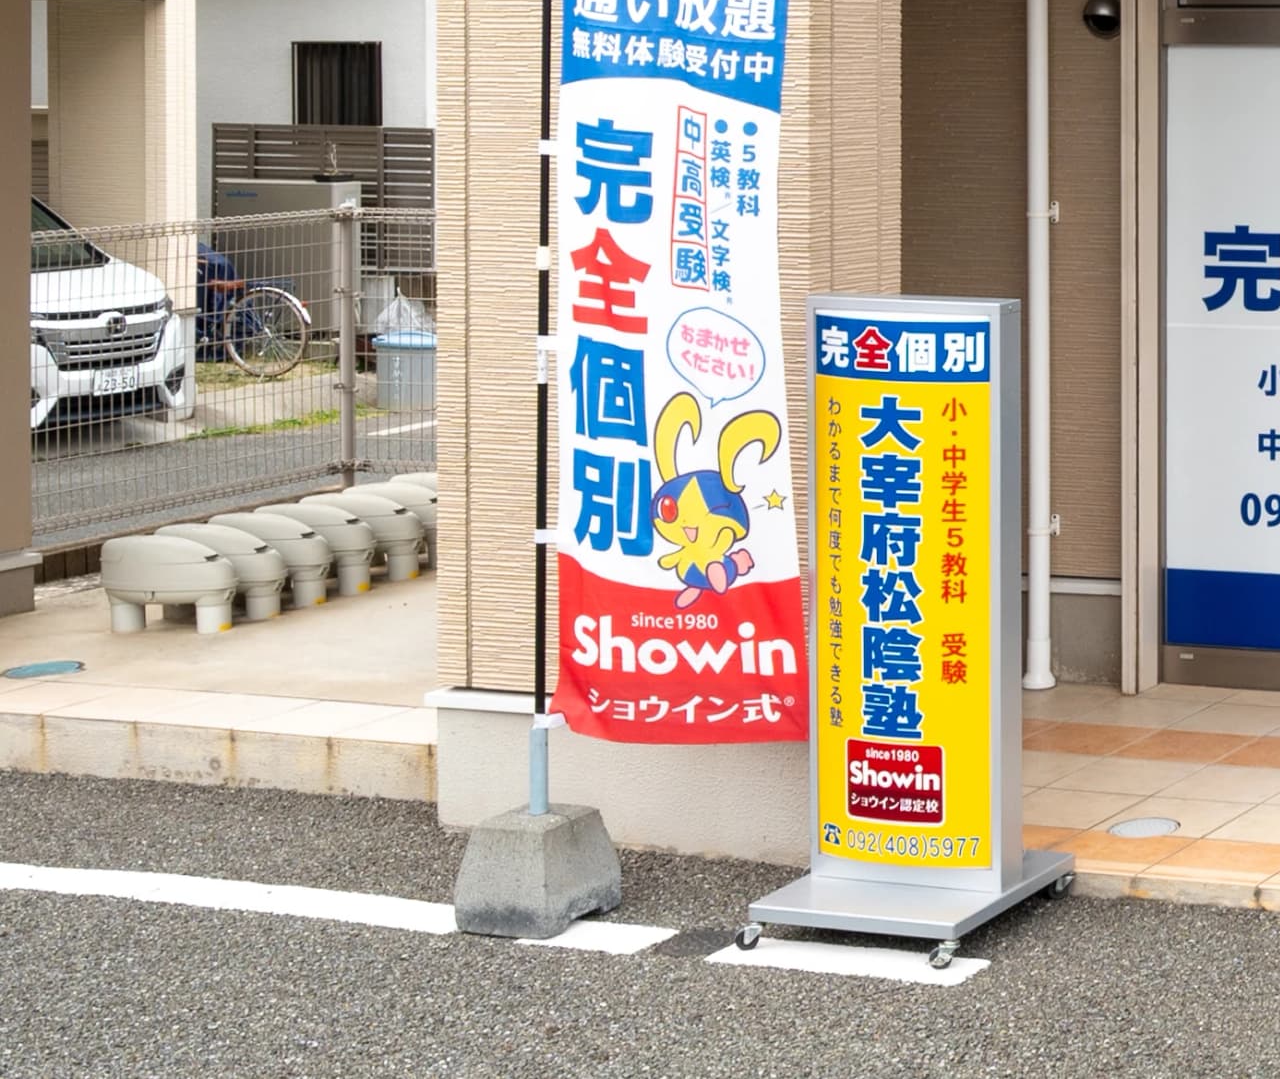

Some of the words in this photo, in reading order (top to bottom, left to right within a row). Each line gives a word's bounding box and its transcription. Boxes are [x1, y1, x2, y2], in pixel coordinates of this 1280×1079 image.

[572, 27, 775, 82] 無料体験受付中
[675, 115, 708, 285] 中高受験
[569, 117, 654, 557] 完全個別
[680, 324, 751, 358] おまかせ
[821, 325, 986, 373] 完全個別
[827, 396, 843, 728] わかるまで何度でも勉強できる塾
[860, 396, 923, 740] 大宰府松陰塾
[572, 614, 798, 675] Showin
[631, 612, 719, 631] since1980
[941, 633, 967, 684] 受験
[849, 760, 941, 791] Showin
[865, 747, 920, 763] since1980
[850, 792, 939, 814] ショウイン認定校
[847, 829, 981, 858] 092(408)5977
